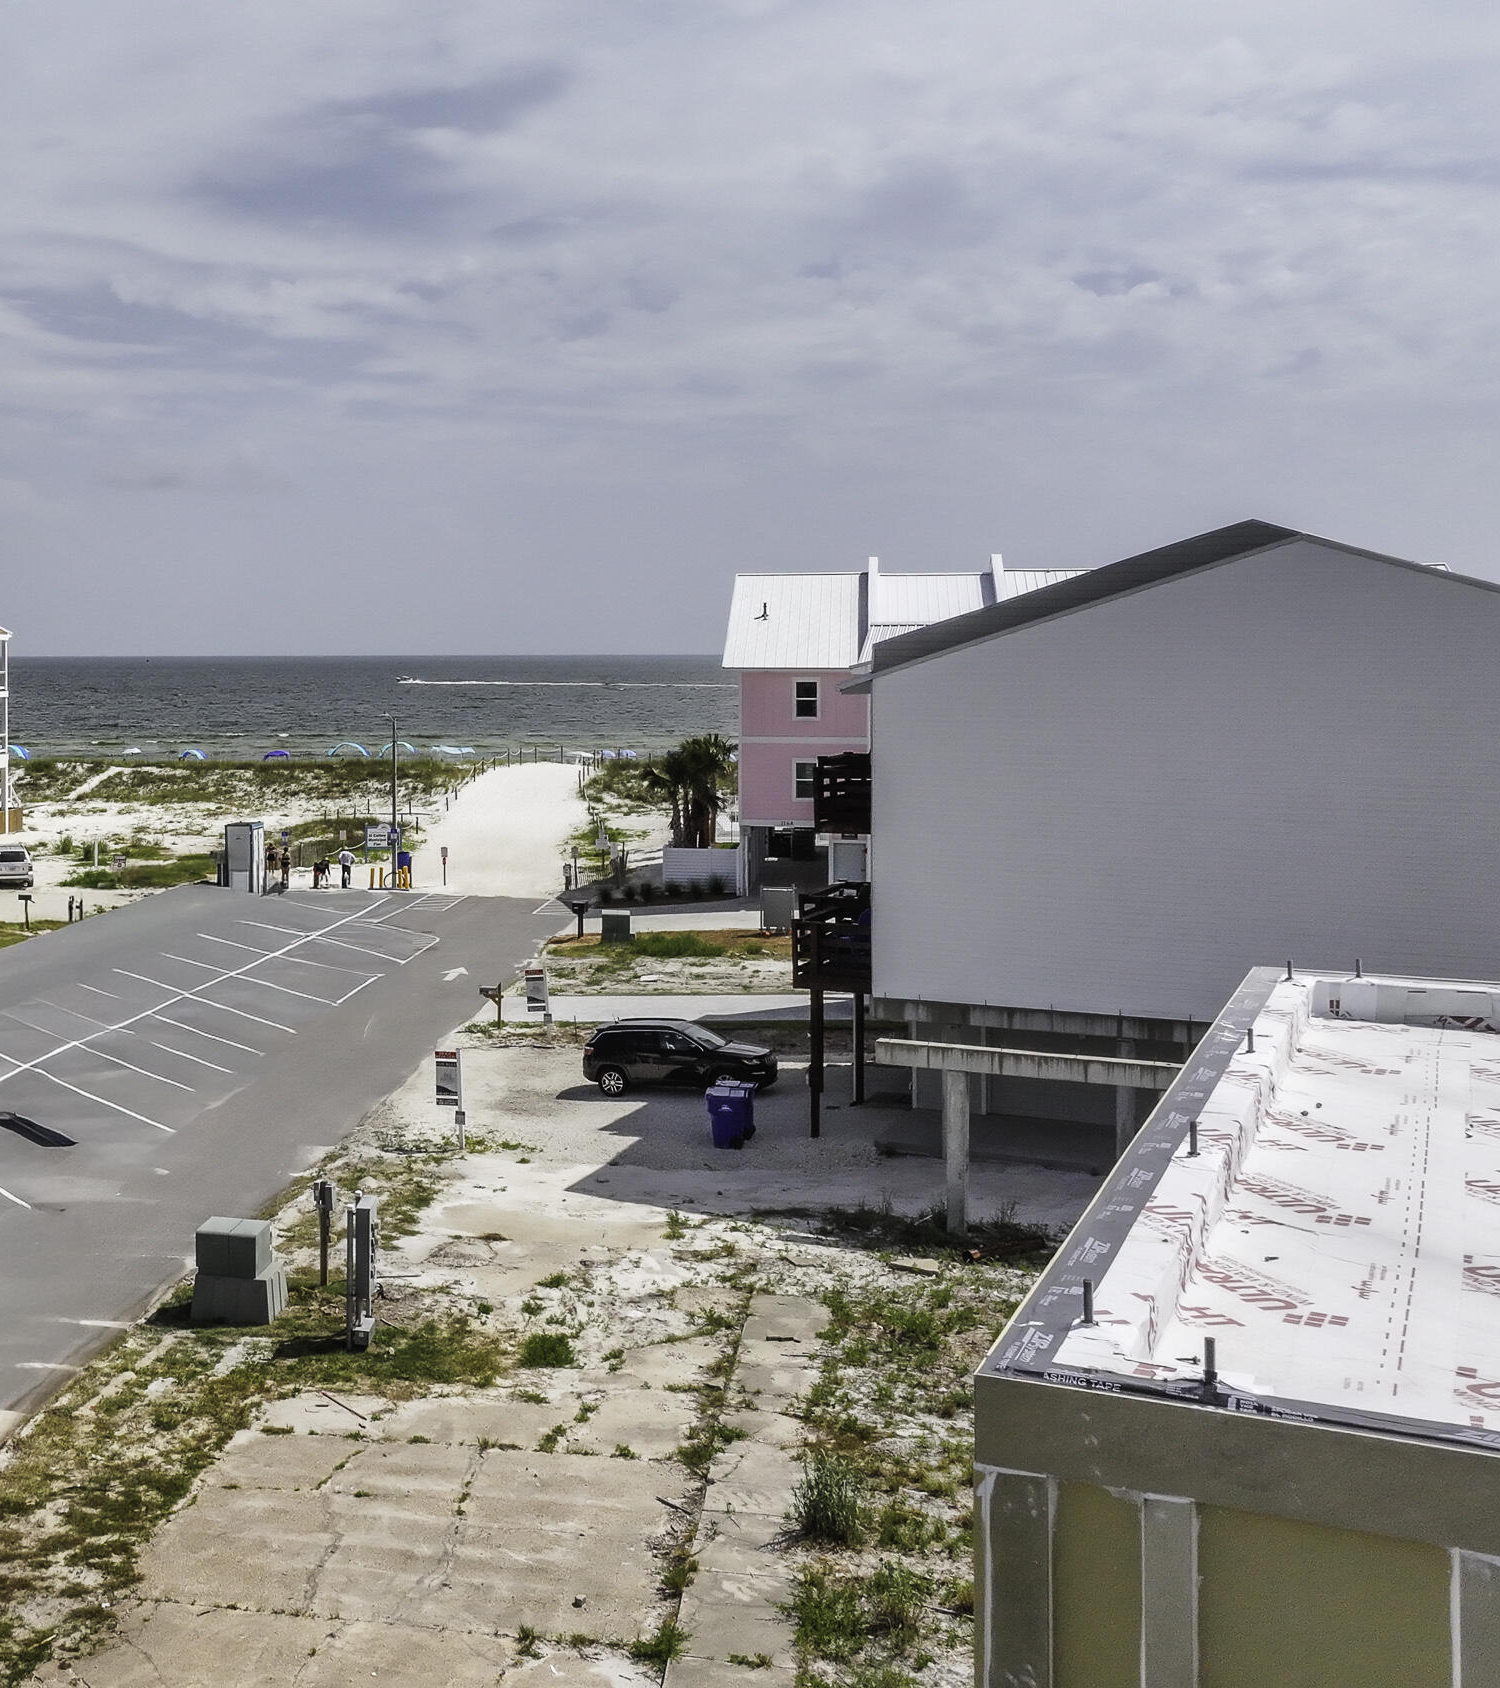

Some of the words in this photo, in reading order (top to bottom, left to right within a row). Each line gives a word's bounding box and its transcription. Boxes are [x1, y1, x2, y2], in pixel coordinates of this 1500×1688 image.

[1234, 1175, 1327, 1213] ULTRA
[1196, 1258, 1298, 1311] ULTRA
[1090, 1379, 1122, 1392] TAPE
